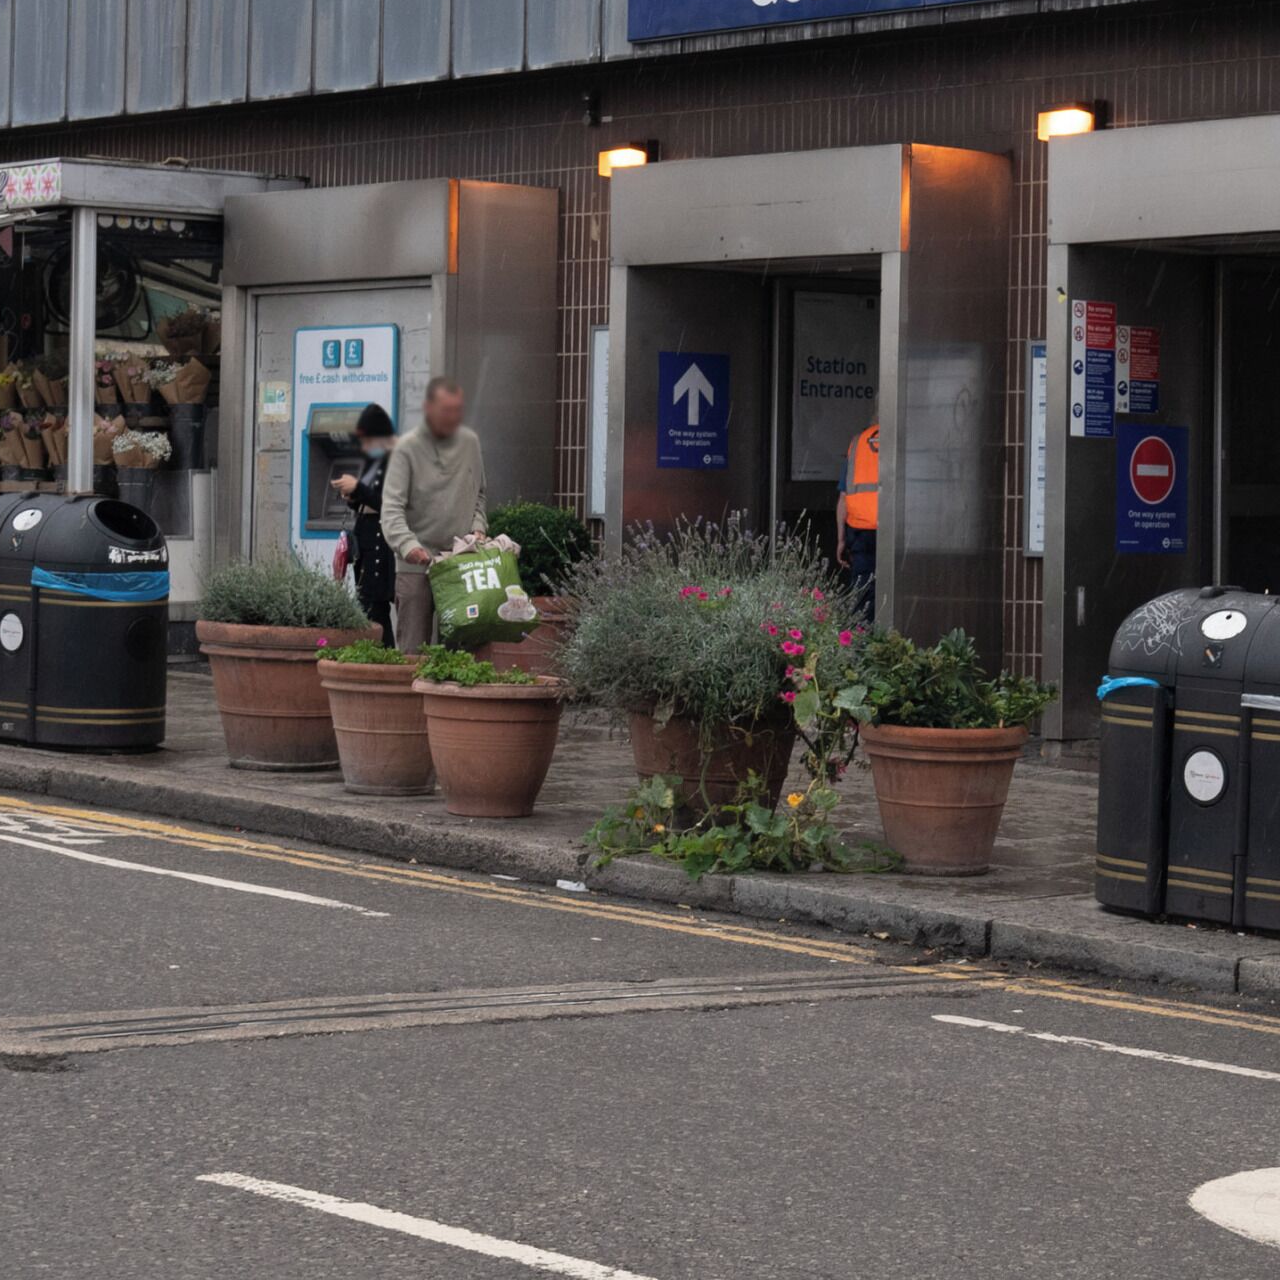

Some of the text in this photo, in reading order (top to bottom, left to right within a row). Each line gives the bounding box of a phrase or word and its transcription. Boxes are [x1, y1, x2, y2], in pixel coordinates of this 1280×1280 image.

[806, 355, 867, 375] Station
[299, 373, 315, 384] free
[342, 371, 389, 383] withdrawals
[799, 379, 875, 399] Entrance
[668, 429, 718, 439] One way system
[682, 439, 711, 448] operation
[1128, 510, 1141, 519] One
[1155, 512, 1177, 520] system
[1141, 521, 1170, 529] operation
[461, 567, 502, 593] TEA
